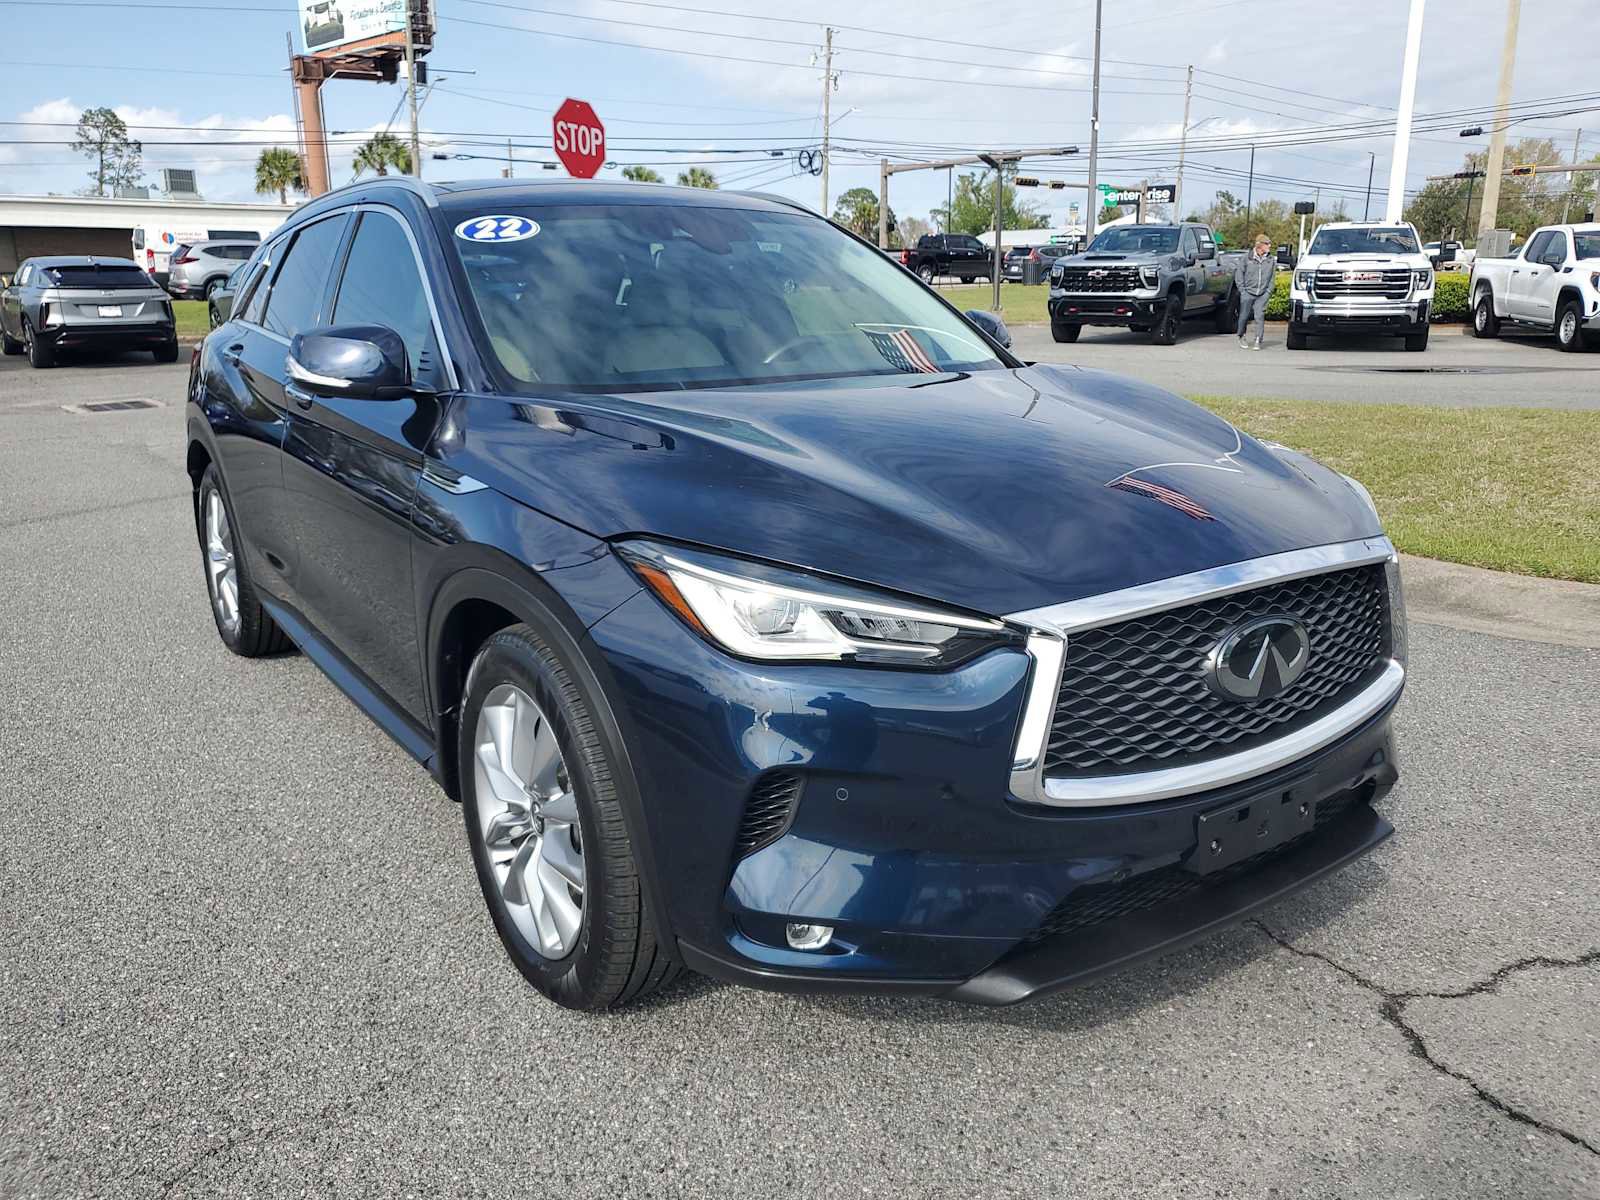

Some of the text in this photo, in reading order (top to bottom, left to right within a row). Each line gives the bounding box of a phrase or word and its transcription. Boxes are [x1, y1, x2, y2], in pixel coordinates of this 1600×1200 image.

[556, 120, 603, 157] STOP
[1107, 188, 1171, 202] enterrise
[473, 218, 523, 239] 22
